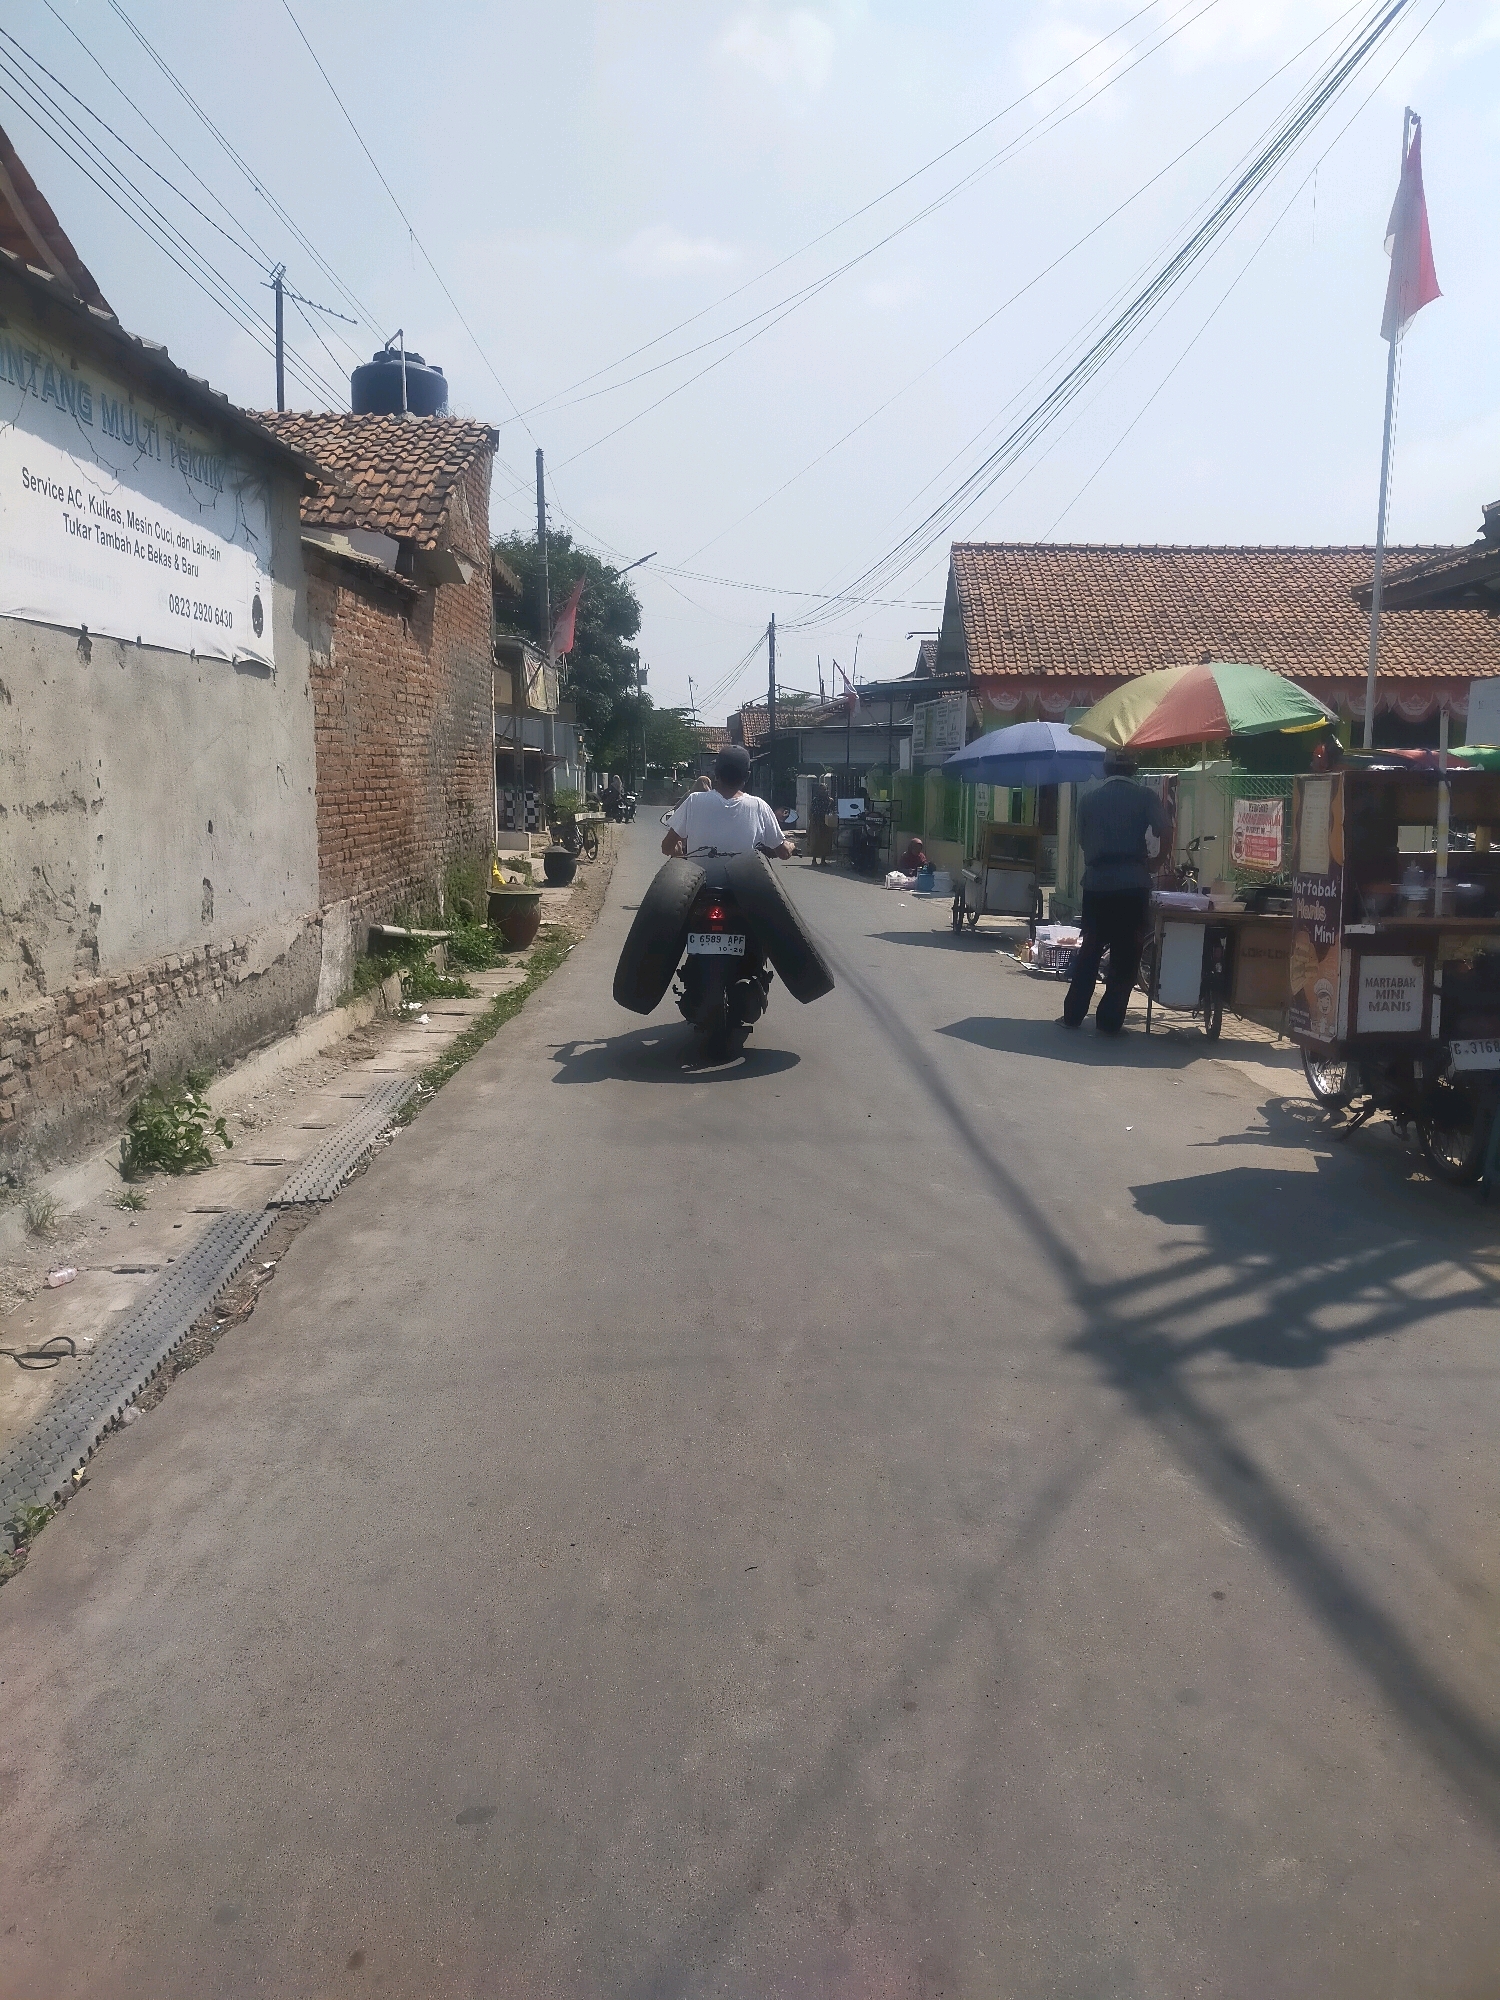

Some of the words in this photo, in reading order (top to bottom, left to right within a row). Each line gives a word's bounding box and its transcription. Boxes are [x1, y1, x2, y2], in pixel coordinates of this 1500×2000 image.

[101, 392, 161, 461] MULTI
[22, 466, 65, 502] Service
[68, 486, 86, 514] AC,
[88, 494, 125, 529] Kulkas,
[126, 509, 153, 537] Mesin
[155, 521, 175, 548] Cuci,
[176, 531, 191, 551] dan
[191, 536, 221, 562] Lain-lain
[62, 512, 92, 541] Tukar
[94, 524, 132, 555] Tambah
[133, 539, 146, 560] Ac
[147, 543, 172, 569] Bekas
[174, 553, 180, 571] &
[181, 556, 199, 578] Baru
[168, 593, 191, 619] 0823
[193, 601, 213, 623] 2920
[214, 607, 233, 629] 6430
[1293, 876, 1337, 898] Martabak
[1296, 897, 1327, 921] Manis
[699, 934, 722, 944] 6589
[728, 935, 745, 945] APF
[1314, 924, 1335, 944] Mini
[1365, 977, 1416, 988] MARTABAK
[1375, 989, 1405, 1000] MINI
[1368, 1000, 1411, 1012] MANIS
